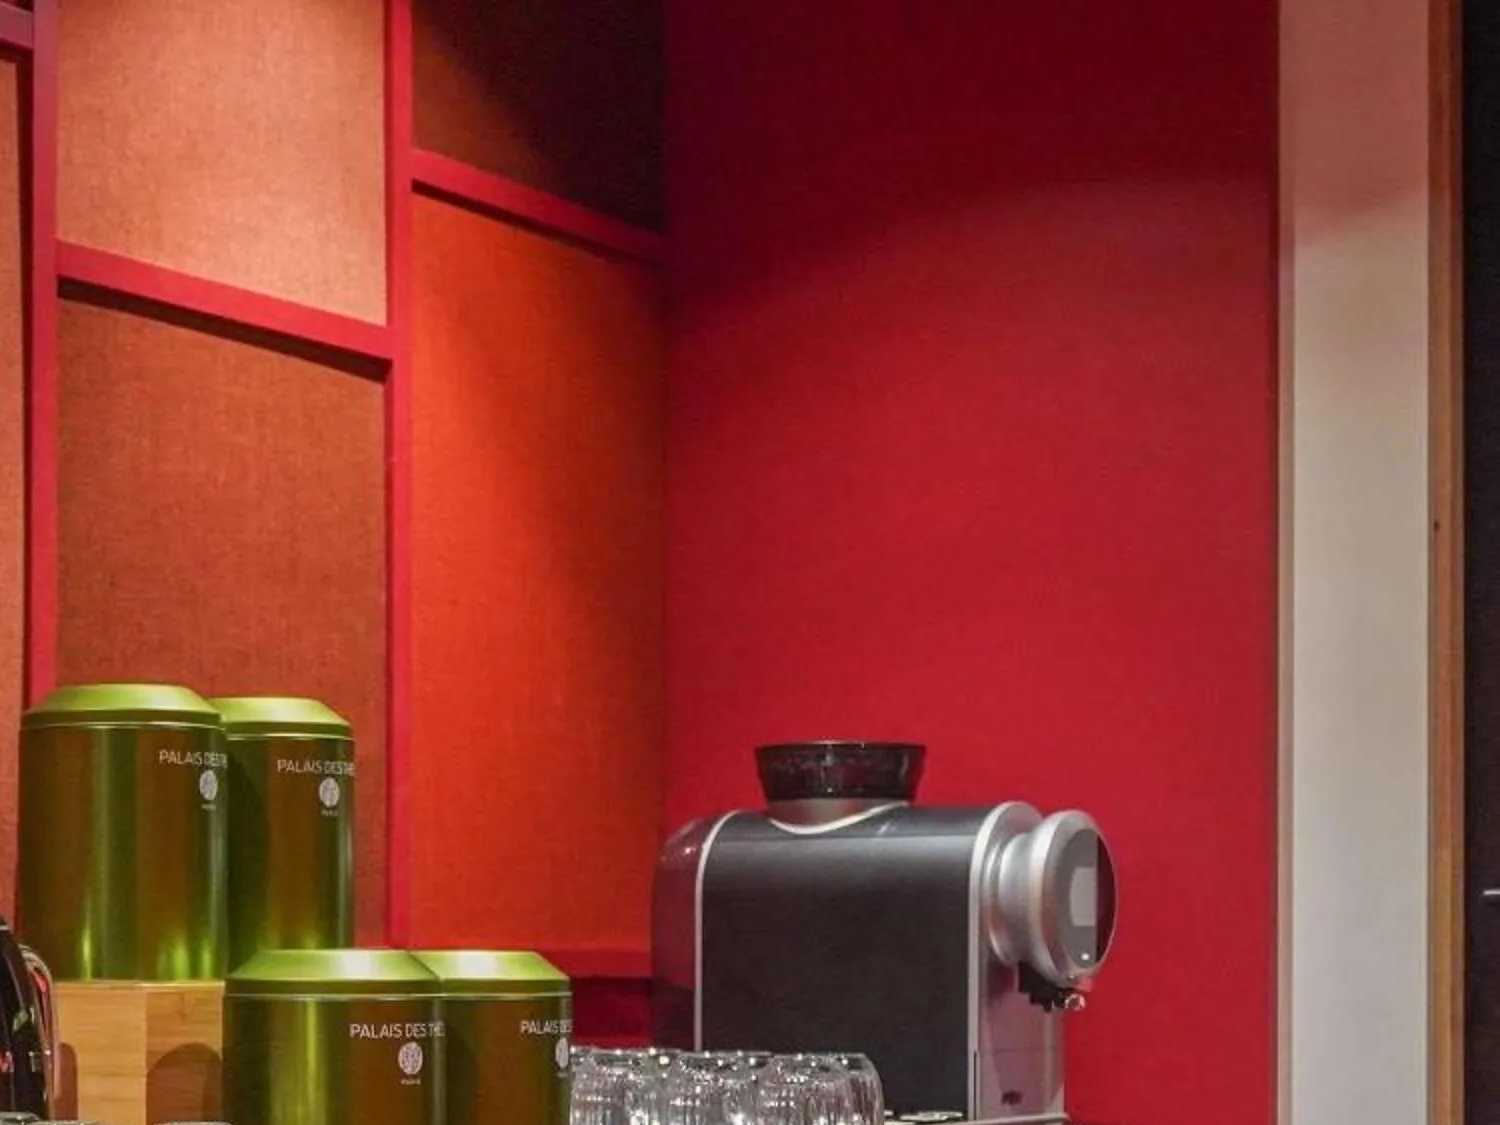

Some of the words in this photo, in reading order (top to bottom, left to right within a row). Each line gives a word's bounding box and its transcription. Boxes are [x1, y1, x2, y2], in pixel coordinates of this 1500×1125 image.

[159, 749, 203, 766] PALAIS
[276, 759, 323, 774] PALAIS
[349, 1022, 403, 1039] PALAIS
[404, 1023, 427, 1038] DES
[520, 1019, 559, 1035] PALAIS
